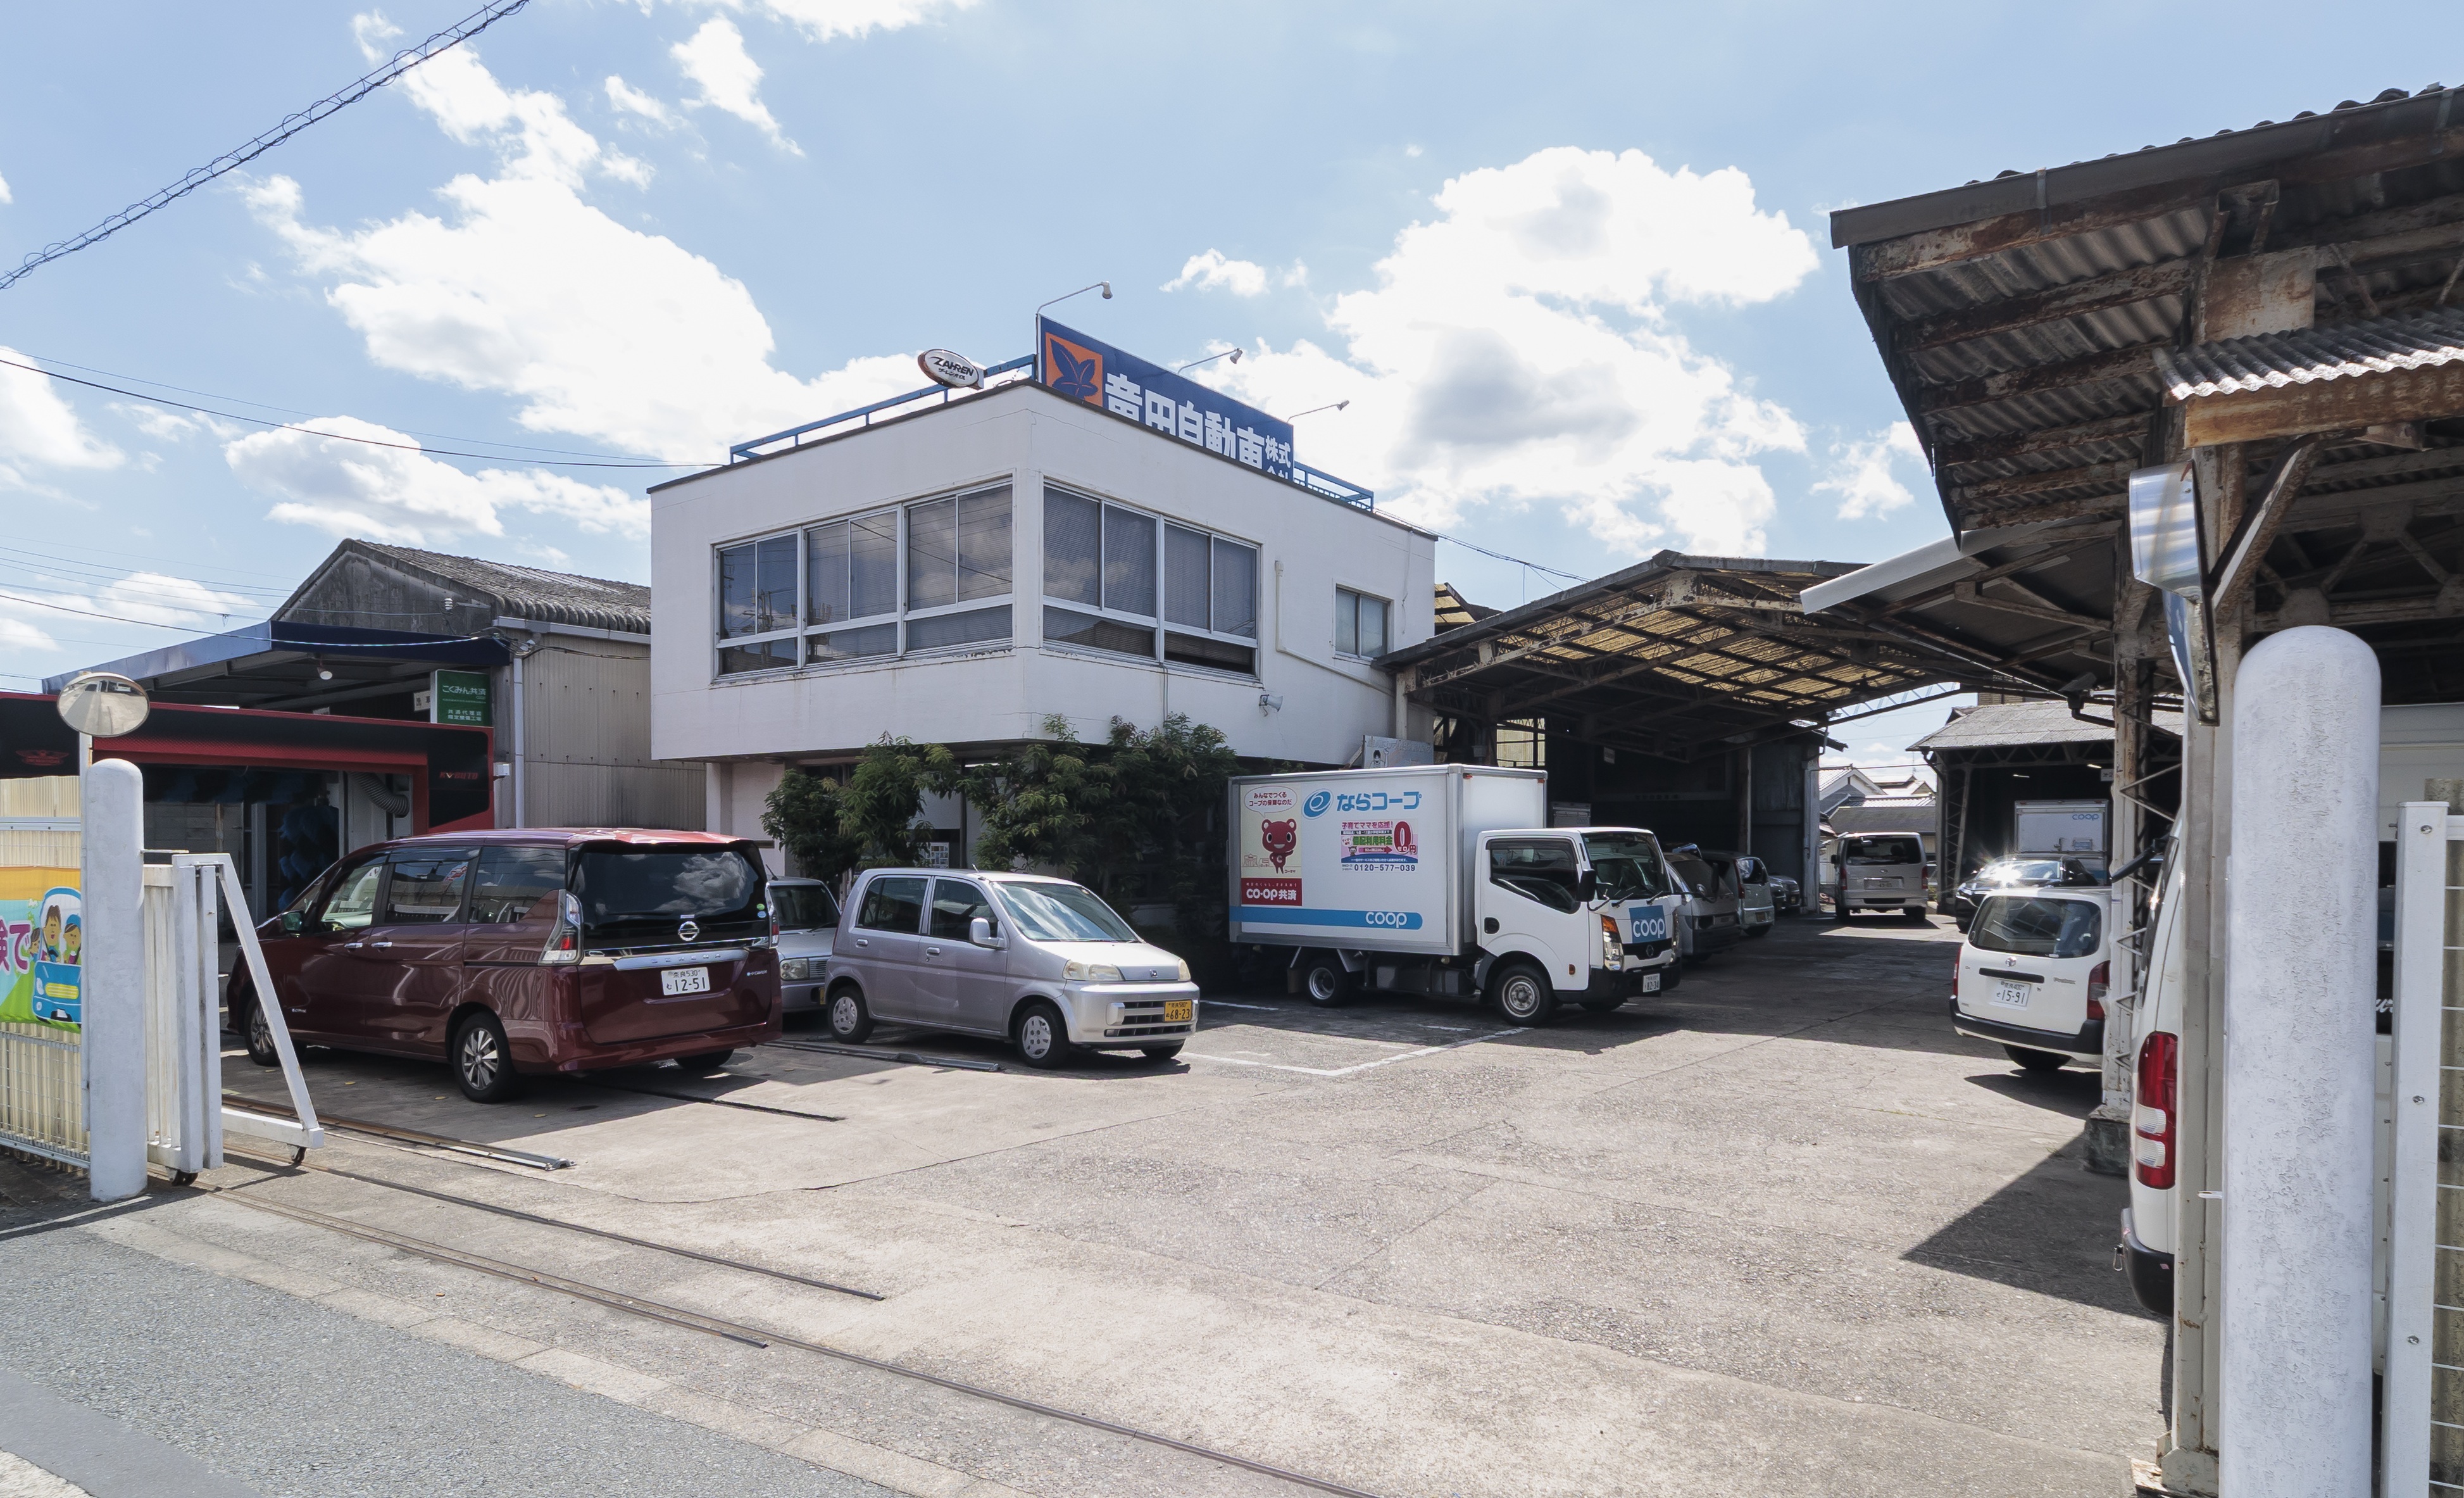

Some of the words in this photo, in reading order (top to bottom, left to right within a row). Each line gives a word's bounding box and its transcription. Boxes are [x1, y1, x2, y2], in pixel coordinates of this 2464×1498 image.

[929, 356, 975, 377] ZAHREN
[1265, 434, 1291, 469] 株式
[442, 685, 487, 696] こくみん共済
[1336, 791, 1423, 812] ならコープ
[1354, 864, 1416, 872] 0120-577-039
[1365, 912, 1408, 929] coop
[1632, 918, 1665, 939] coop
